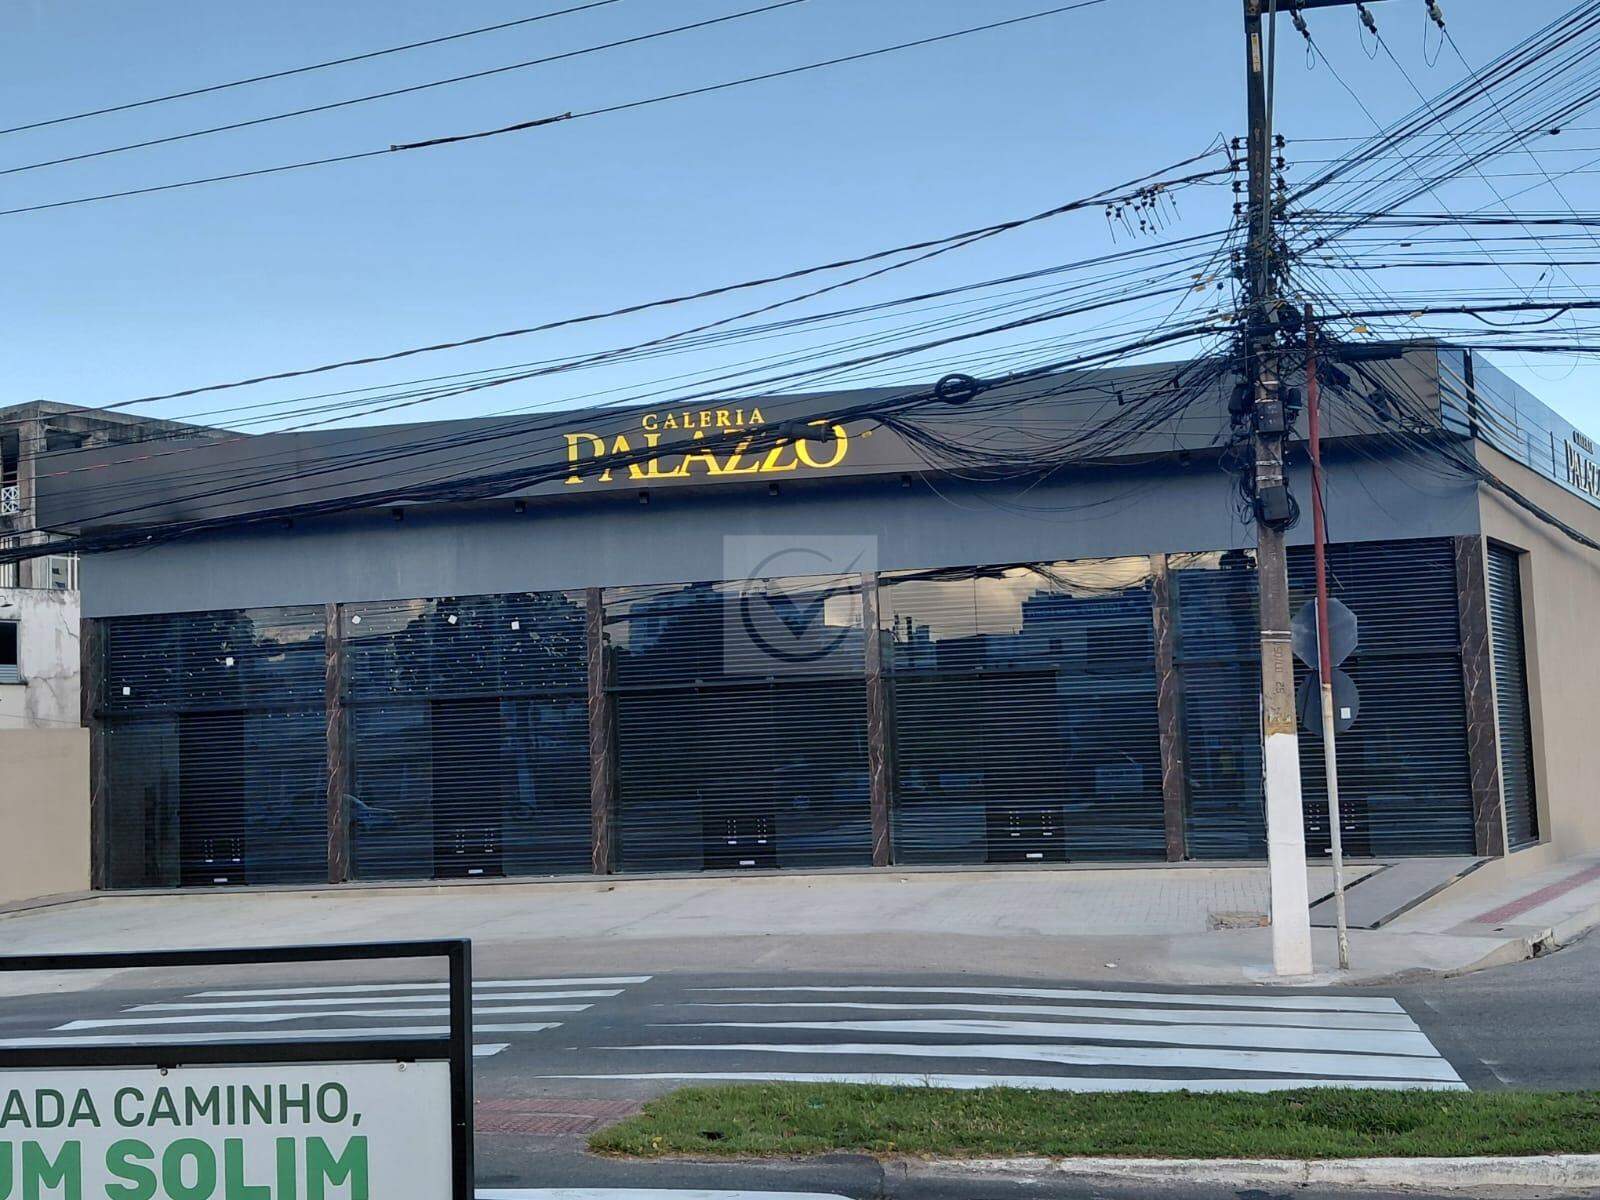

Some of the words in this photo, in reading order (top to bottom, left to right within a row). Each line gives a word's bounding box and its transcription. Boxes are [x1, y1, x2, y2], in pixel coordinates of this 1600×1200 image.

[642, 407, 765, 430] GALERIA
[563, 420, 848, 485] PALAZZO
[0, 1087, 101, 1128] ADA
[113, 1082, 362, 1127] CAMINHO,
[0, 1140, 82, 1200] M
[104, 1136, 369, 1200] SOLIM
